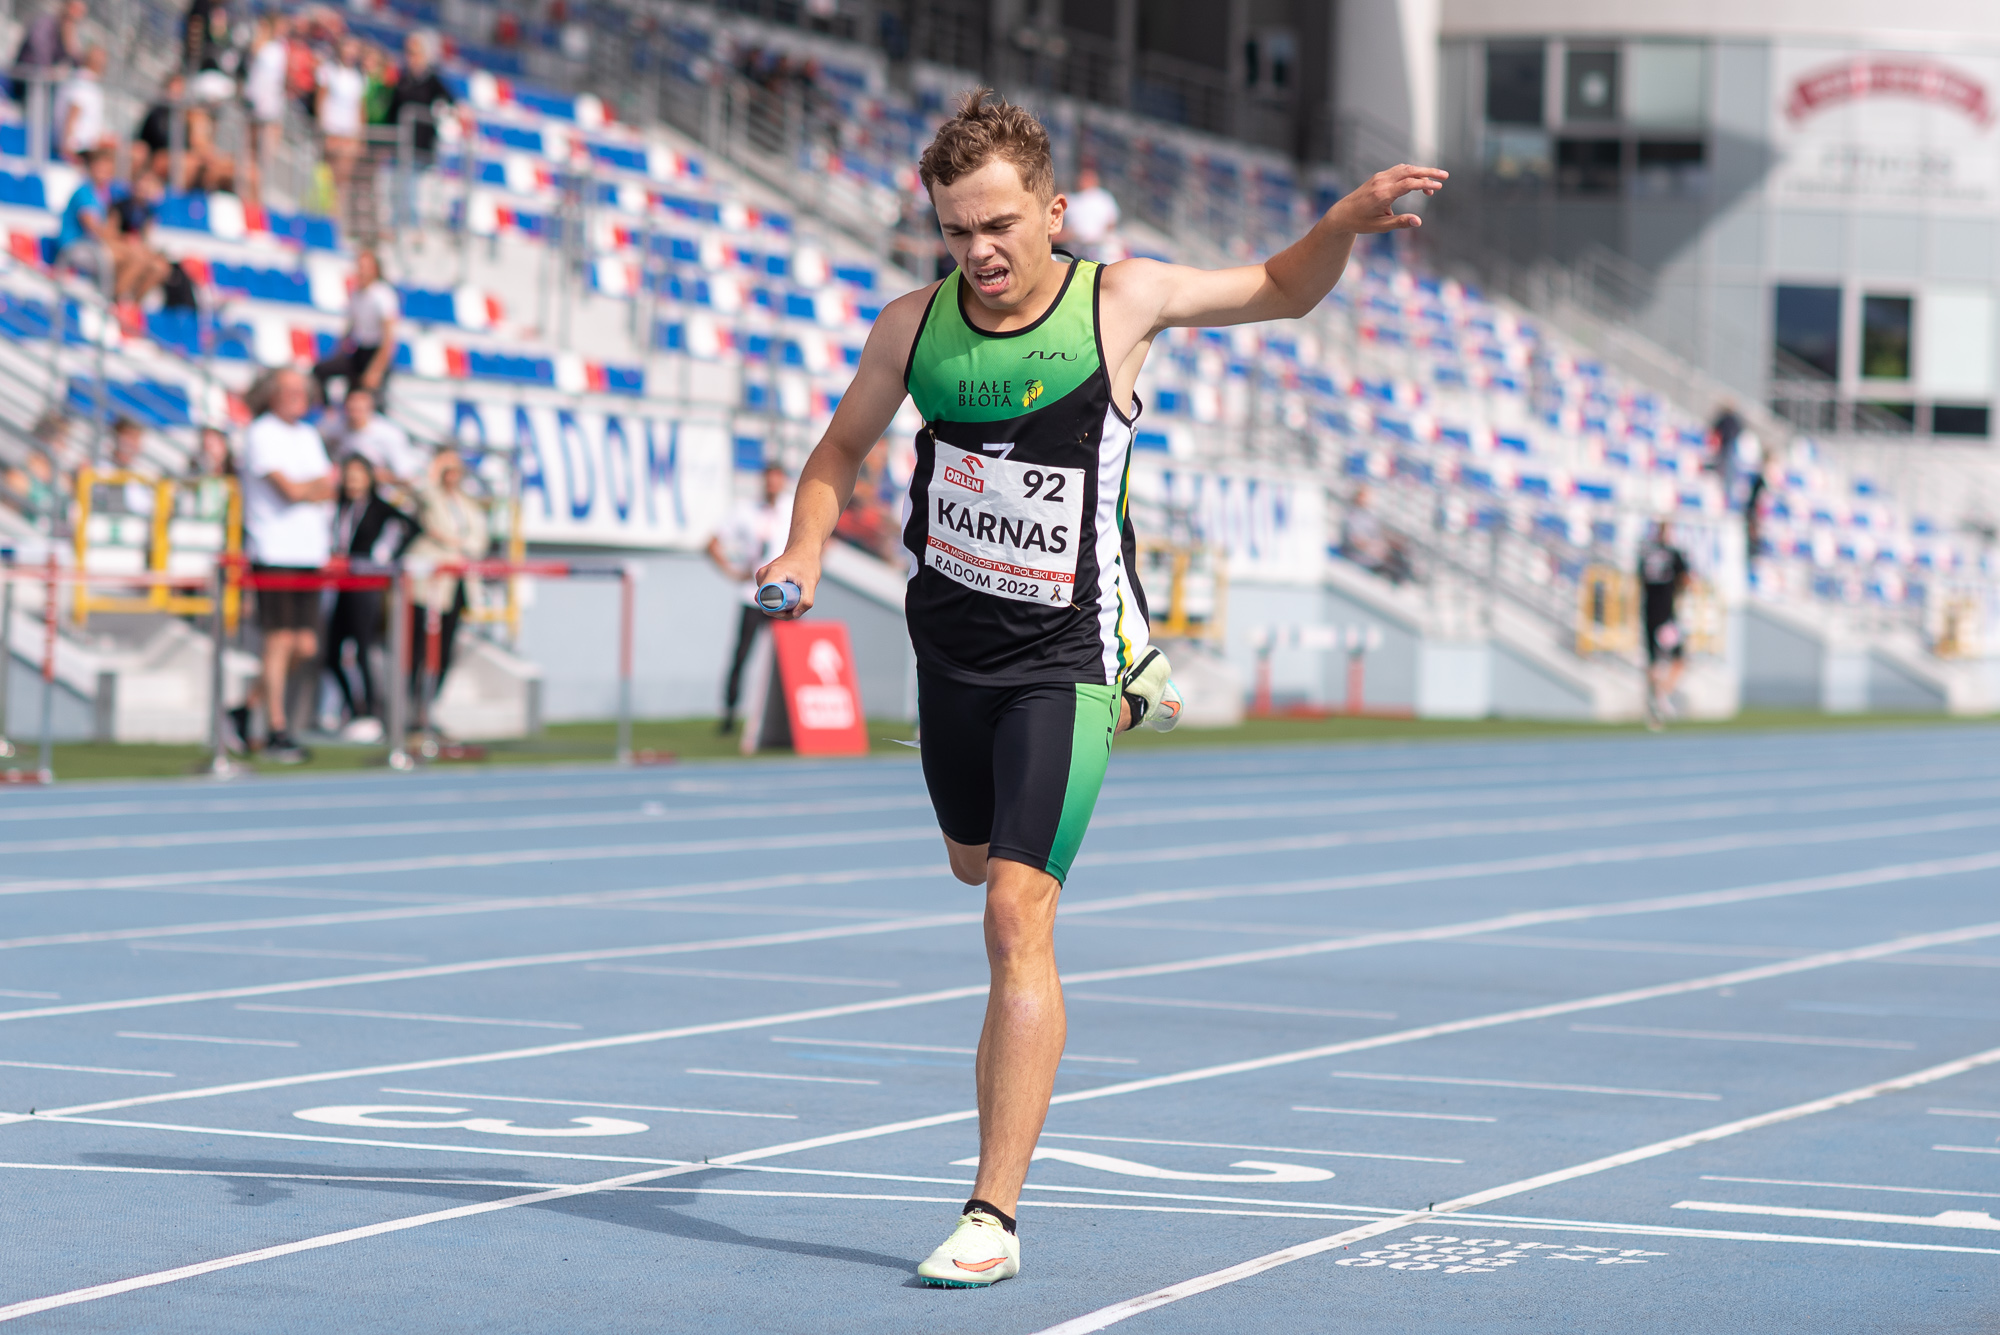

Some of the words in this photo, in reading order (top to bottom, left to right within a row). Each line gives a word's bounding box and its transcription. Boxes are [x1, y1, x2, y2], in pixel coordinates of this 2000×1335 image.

[958, 380, 1012, 394] BIAŁE
[958, 394, 1013, 408] BŁOTA
[945, 468, 981, 492] ORLEN
[1023, 470, 1066, 502] 92
[938, 498, 1069, 554] KARNAS
[930, 537, 950, 553] PZLA
[951, 547, 1012, 573] MISTRZOSTWA
[1013, 566, 1049, 580] POLSKI
[1050, 573, 1072, 583] U20
[935, 554, 991, 589] RADOM
[996, 577, 1039, 598] 2022
[293, 1105, 651, 1137] 3
[948, 1147, 1336, 1183] 2
[1334, 1257, 1497, 1274] 400
